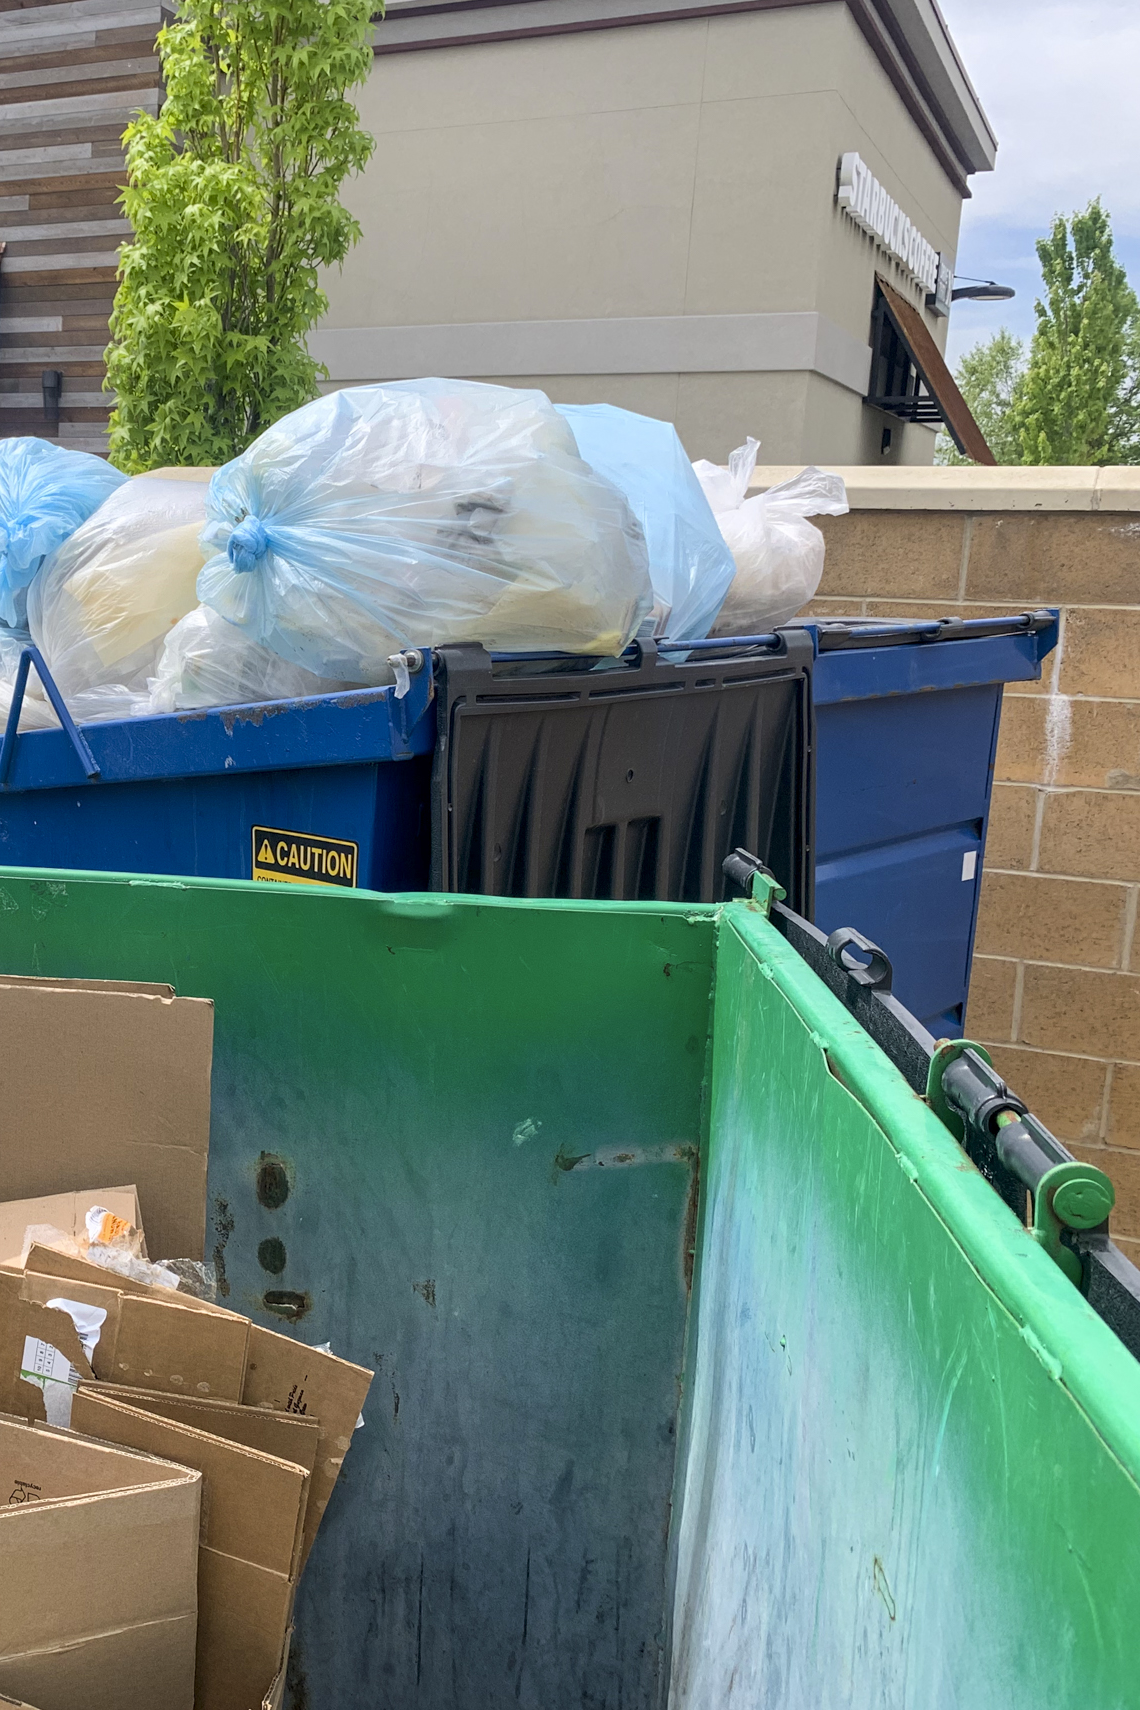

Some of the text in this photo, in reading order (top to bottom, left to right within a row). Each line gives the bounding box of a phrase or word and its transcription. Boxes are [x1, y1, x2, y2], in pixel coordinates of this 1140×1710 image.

[838, 152, 939, 294] STARBUCKS COFFEE
[276, 841, 351, 879] CAUTION
